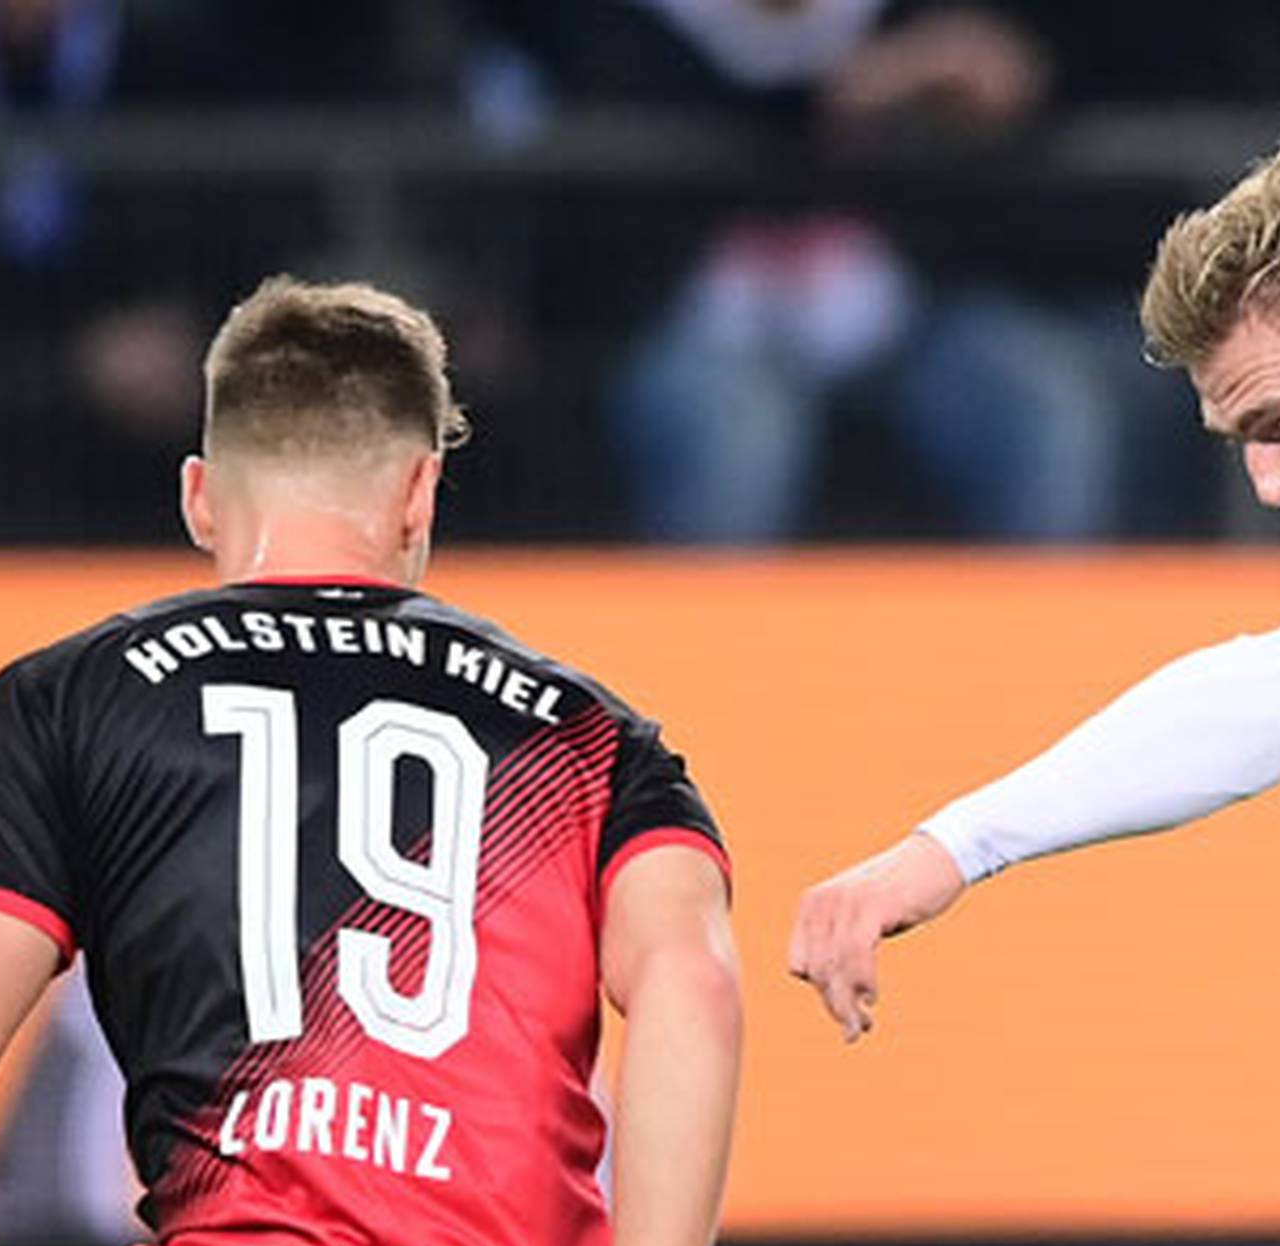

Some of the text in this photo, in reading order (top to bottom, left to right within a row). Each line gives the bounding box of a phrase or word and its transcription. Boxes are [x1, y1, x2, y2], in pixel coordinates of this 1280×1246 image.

[125, 611, 565, 724] HOLSTEIN KIEL
[200, 683, 490, 1060] 19
[217, 1076, 455, 1181] LORENZ
